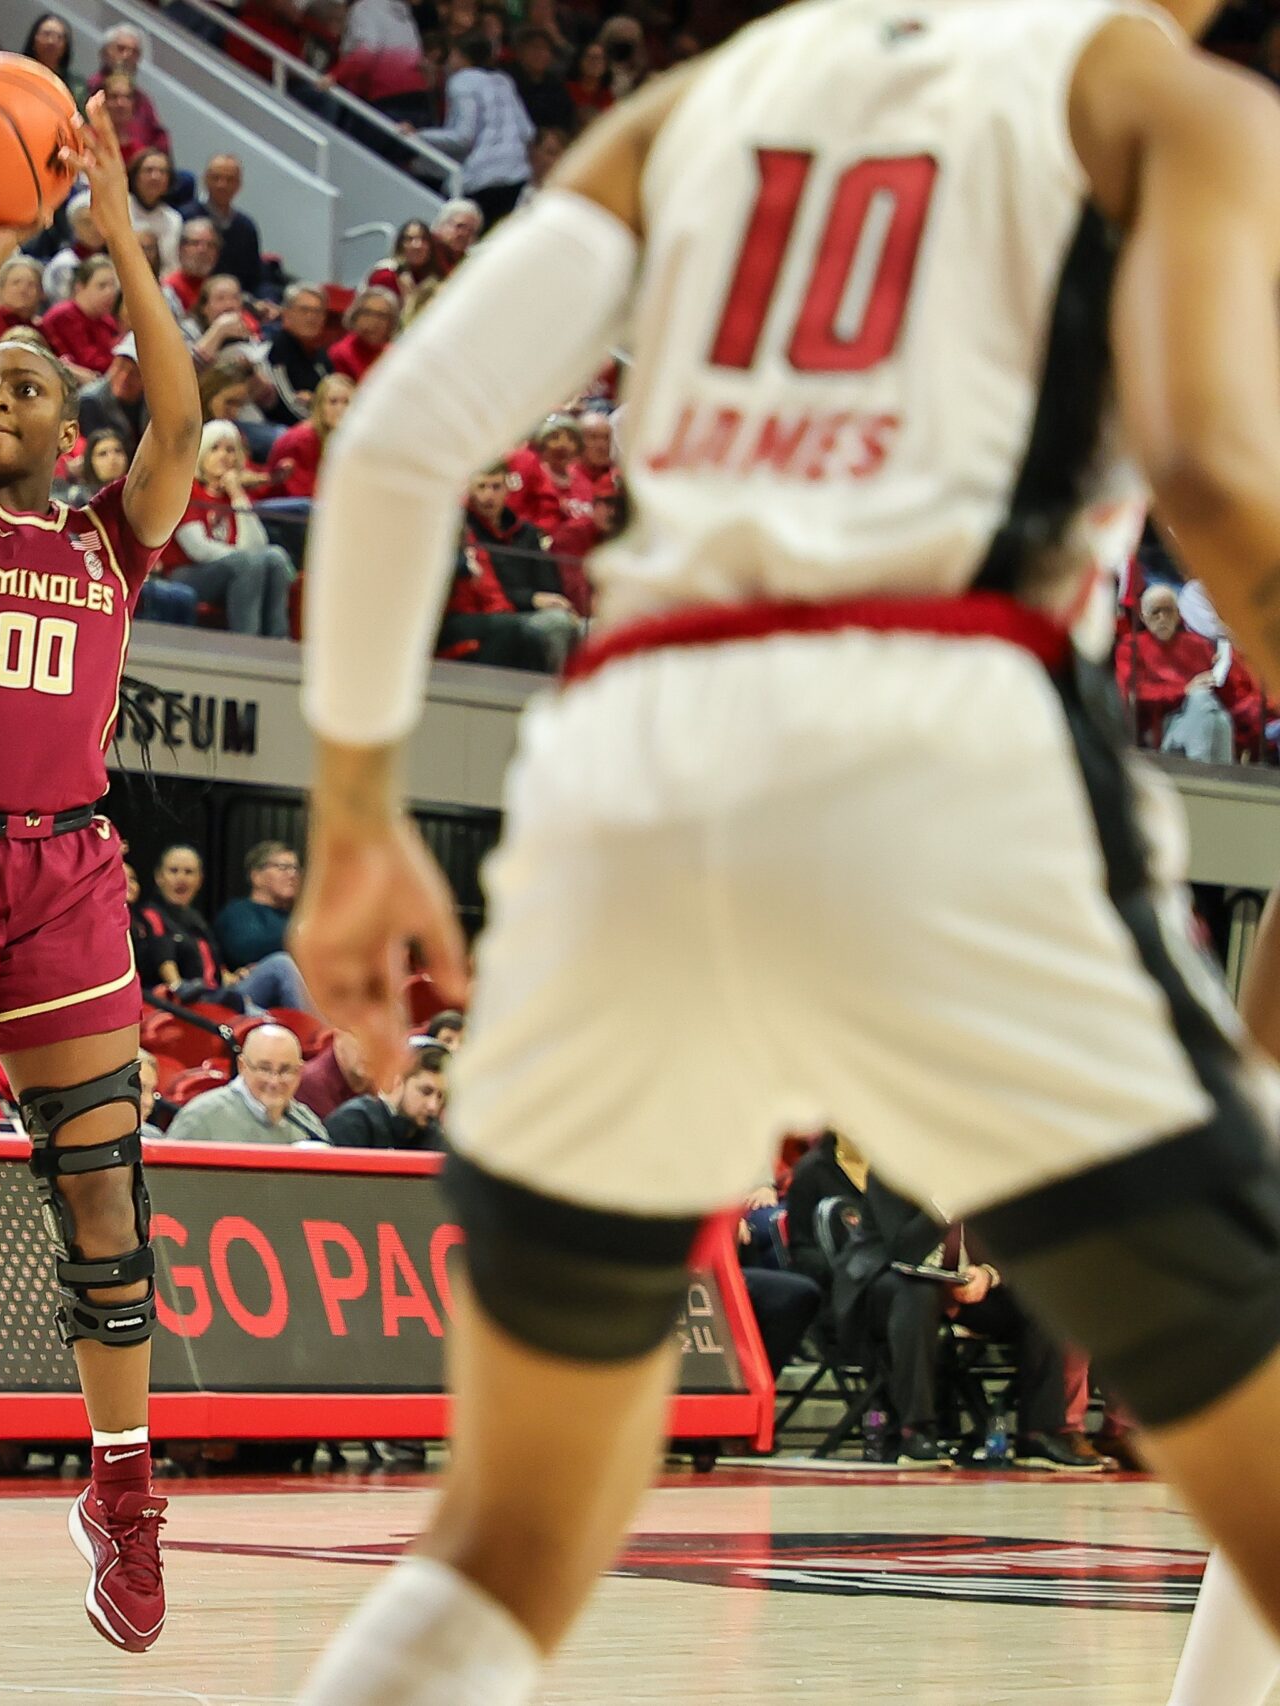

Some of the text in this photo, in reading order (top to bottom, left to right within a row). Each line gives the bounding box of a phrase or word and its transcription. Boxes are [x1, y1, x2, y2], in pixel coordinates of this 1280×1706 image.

[707, 147, 939, 374] 10
[647, 399, 901, 480] JAMES
[148, 1212, 290, 1340] GO
